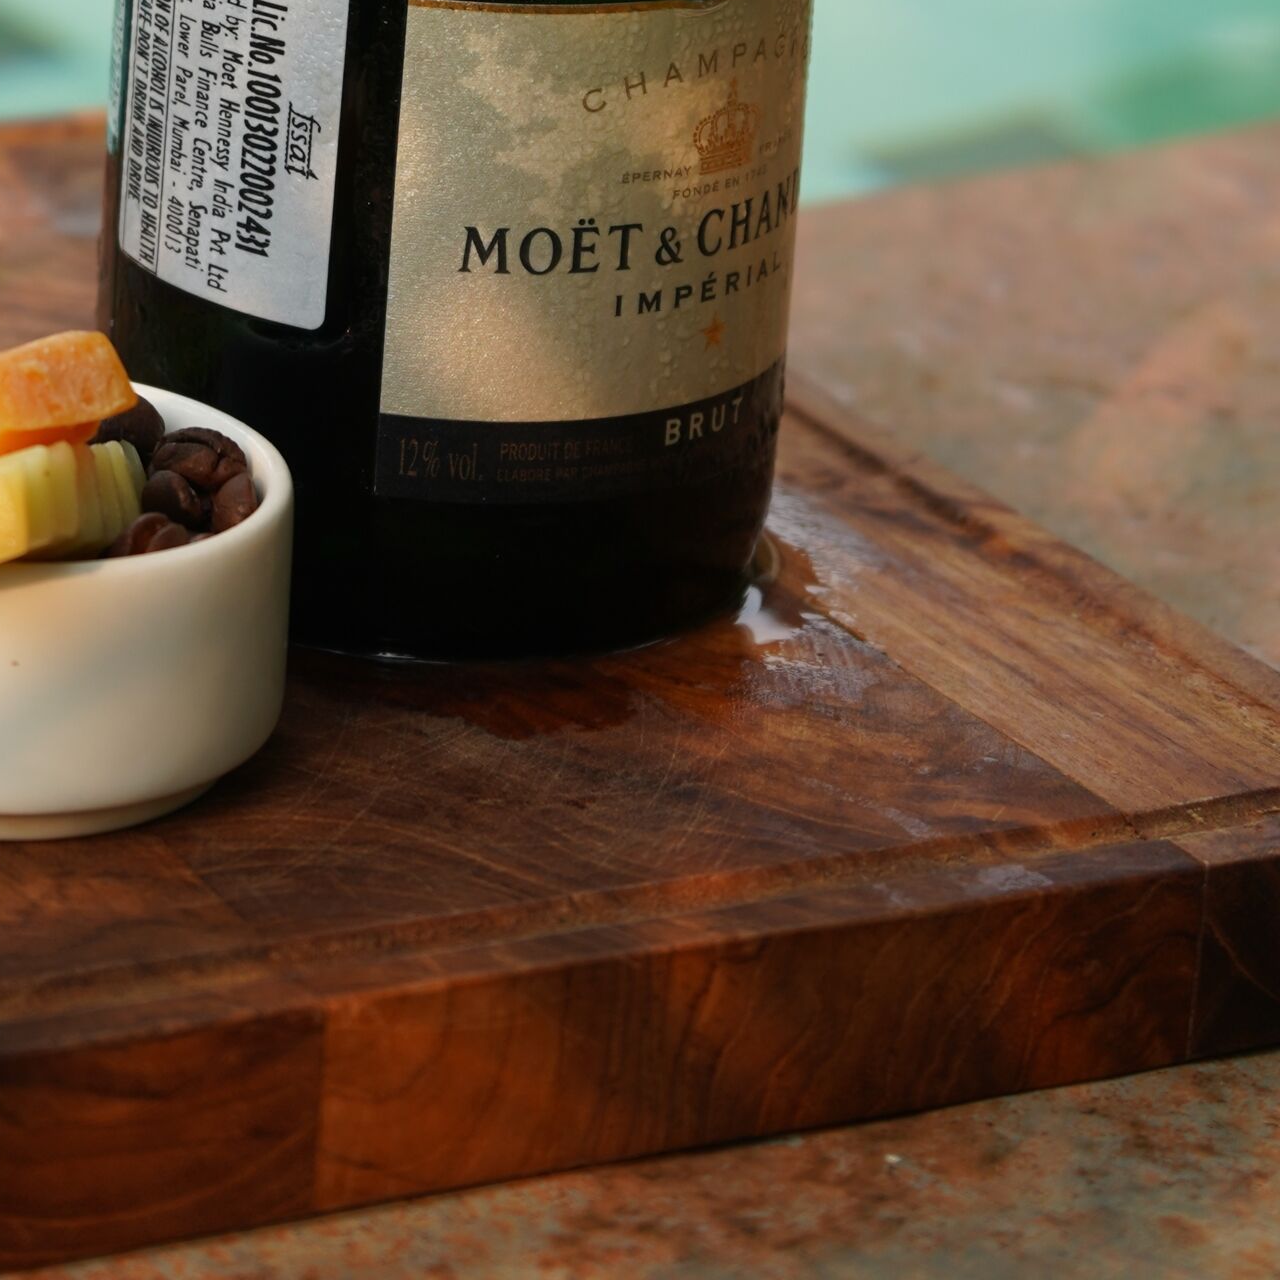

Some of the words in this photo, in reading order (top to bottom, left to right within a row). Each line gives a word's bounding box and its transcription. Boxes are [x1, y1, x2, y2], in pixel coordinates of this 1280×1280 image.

[156, 15, 170, 36] OF
[176, 14, 194, 58] Lower
[198, 20, 222, 58] Bulls
[218, 15, 247, 40] by:
[149, 36, 168, 96] ALCOHOL
[220, 49, 243, 89] Moet
[133, 81, 148, 124] DRINK
[149, 98, 163, 109] IS
[171, 67, 192, 106] Parel,
[194, 68, 216, 128] Finance
[130, 124, 144, 156] AND
[144, 114, 163, 186] INJURIOUS
[169, 116, 189, 174] Mumbai
[212, 98, 240, 171] Hennessy
[128, 160, 142, 201] DRIVE
[187, 138, 212, 192] Centre,
[622, 166, 692, 184] ÉPERNAY
[142, 189, 158, 208] TO
[211, 179, 236, 217] India
[672, 178, 719, 201] FONDÉ
[725, 178, 740, 190] EN
[164, 196, 184, 254] 400013
[181, 201, 208, 272] Senapati
[210, 228, 233, 256] Pvt
[458, 218, 643, 276] MOËT
[654, 227, 684, 266] &
[207, 264, 230, 293] Ltd
[614, 251, 781, 317] IMPÉRIAL
[665, 397, 744, 448] BRUT
[448, 442, 484, 481] vol.
[500, 441, 560, 461] PRODUIT
[564, 440, 581, 459] DE
